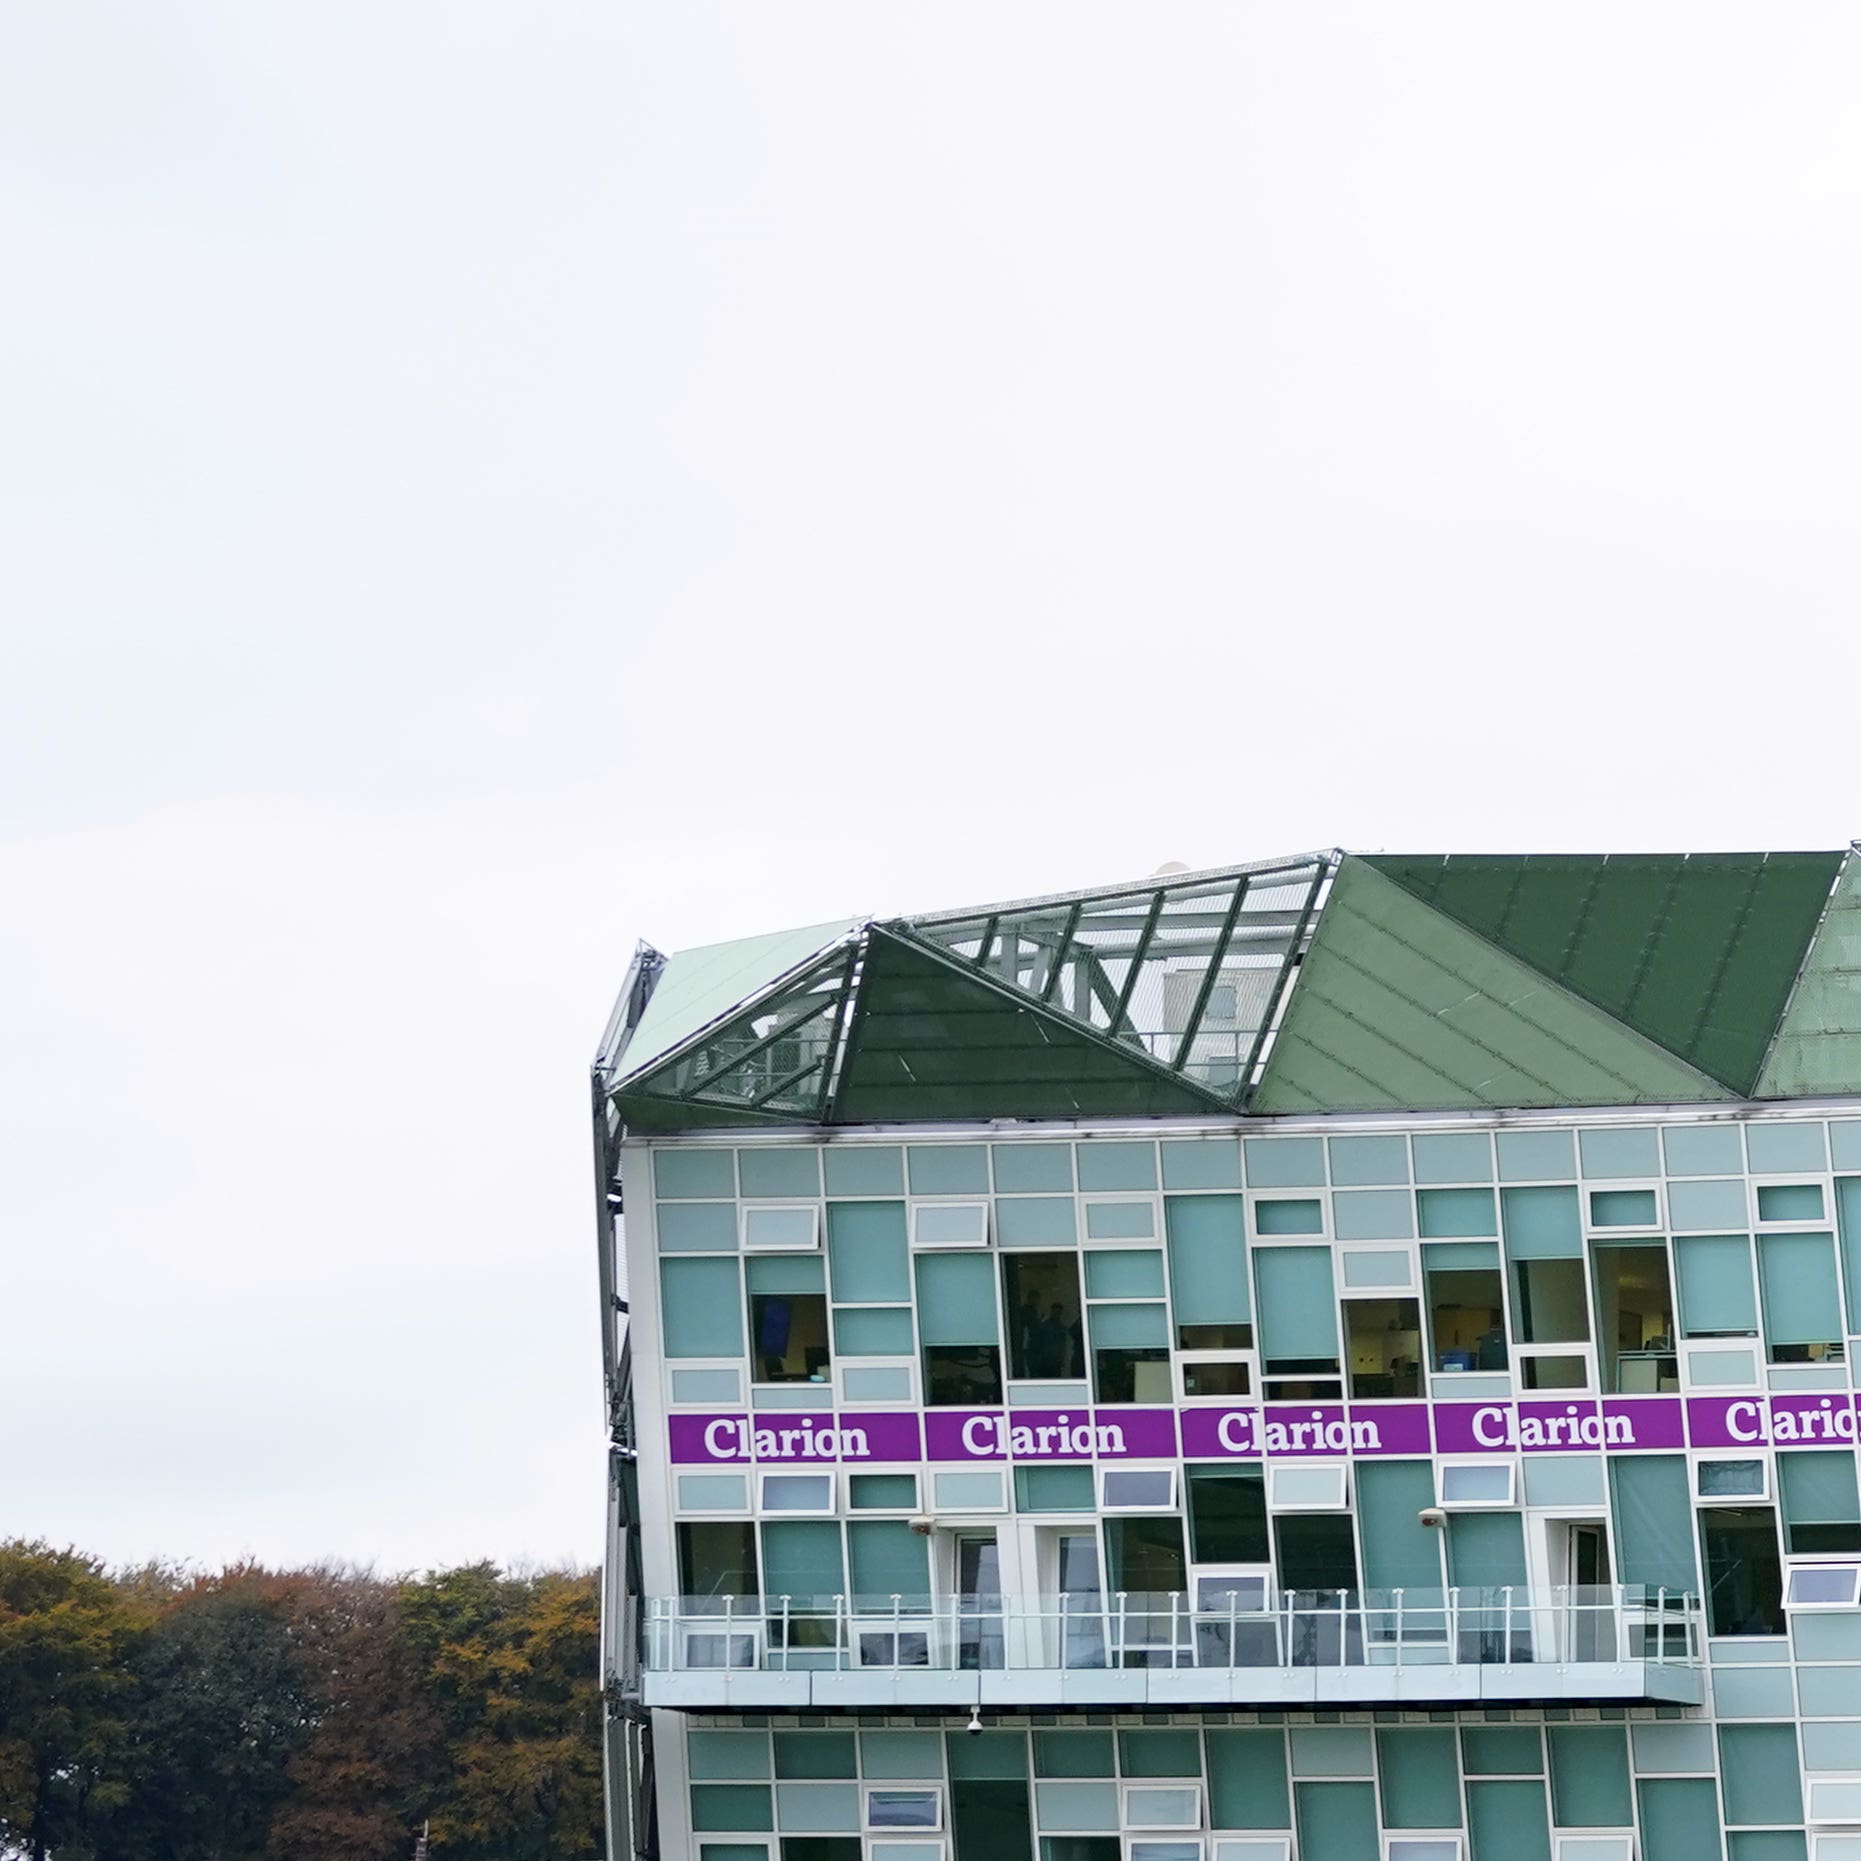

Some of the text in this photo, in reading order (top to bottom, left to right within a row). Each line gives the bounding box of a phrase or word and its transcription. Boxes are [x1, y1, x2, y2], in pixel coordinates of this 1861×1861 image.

[704, 1418, 870, 1457] Clarion
[961, 1415, 1127, 1455] Clarion
[1218, 1410, 1381, 1452] Clarion
[1472, 1405, 1635, 1448] Clarion
